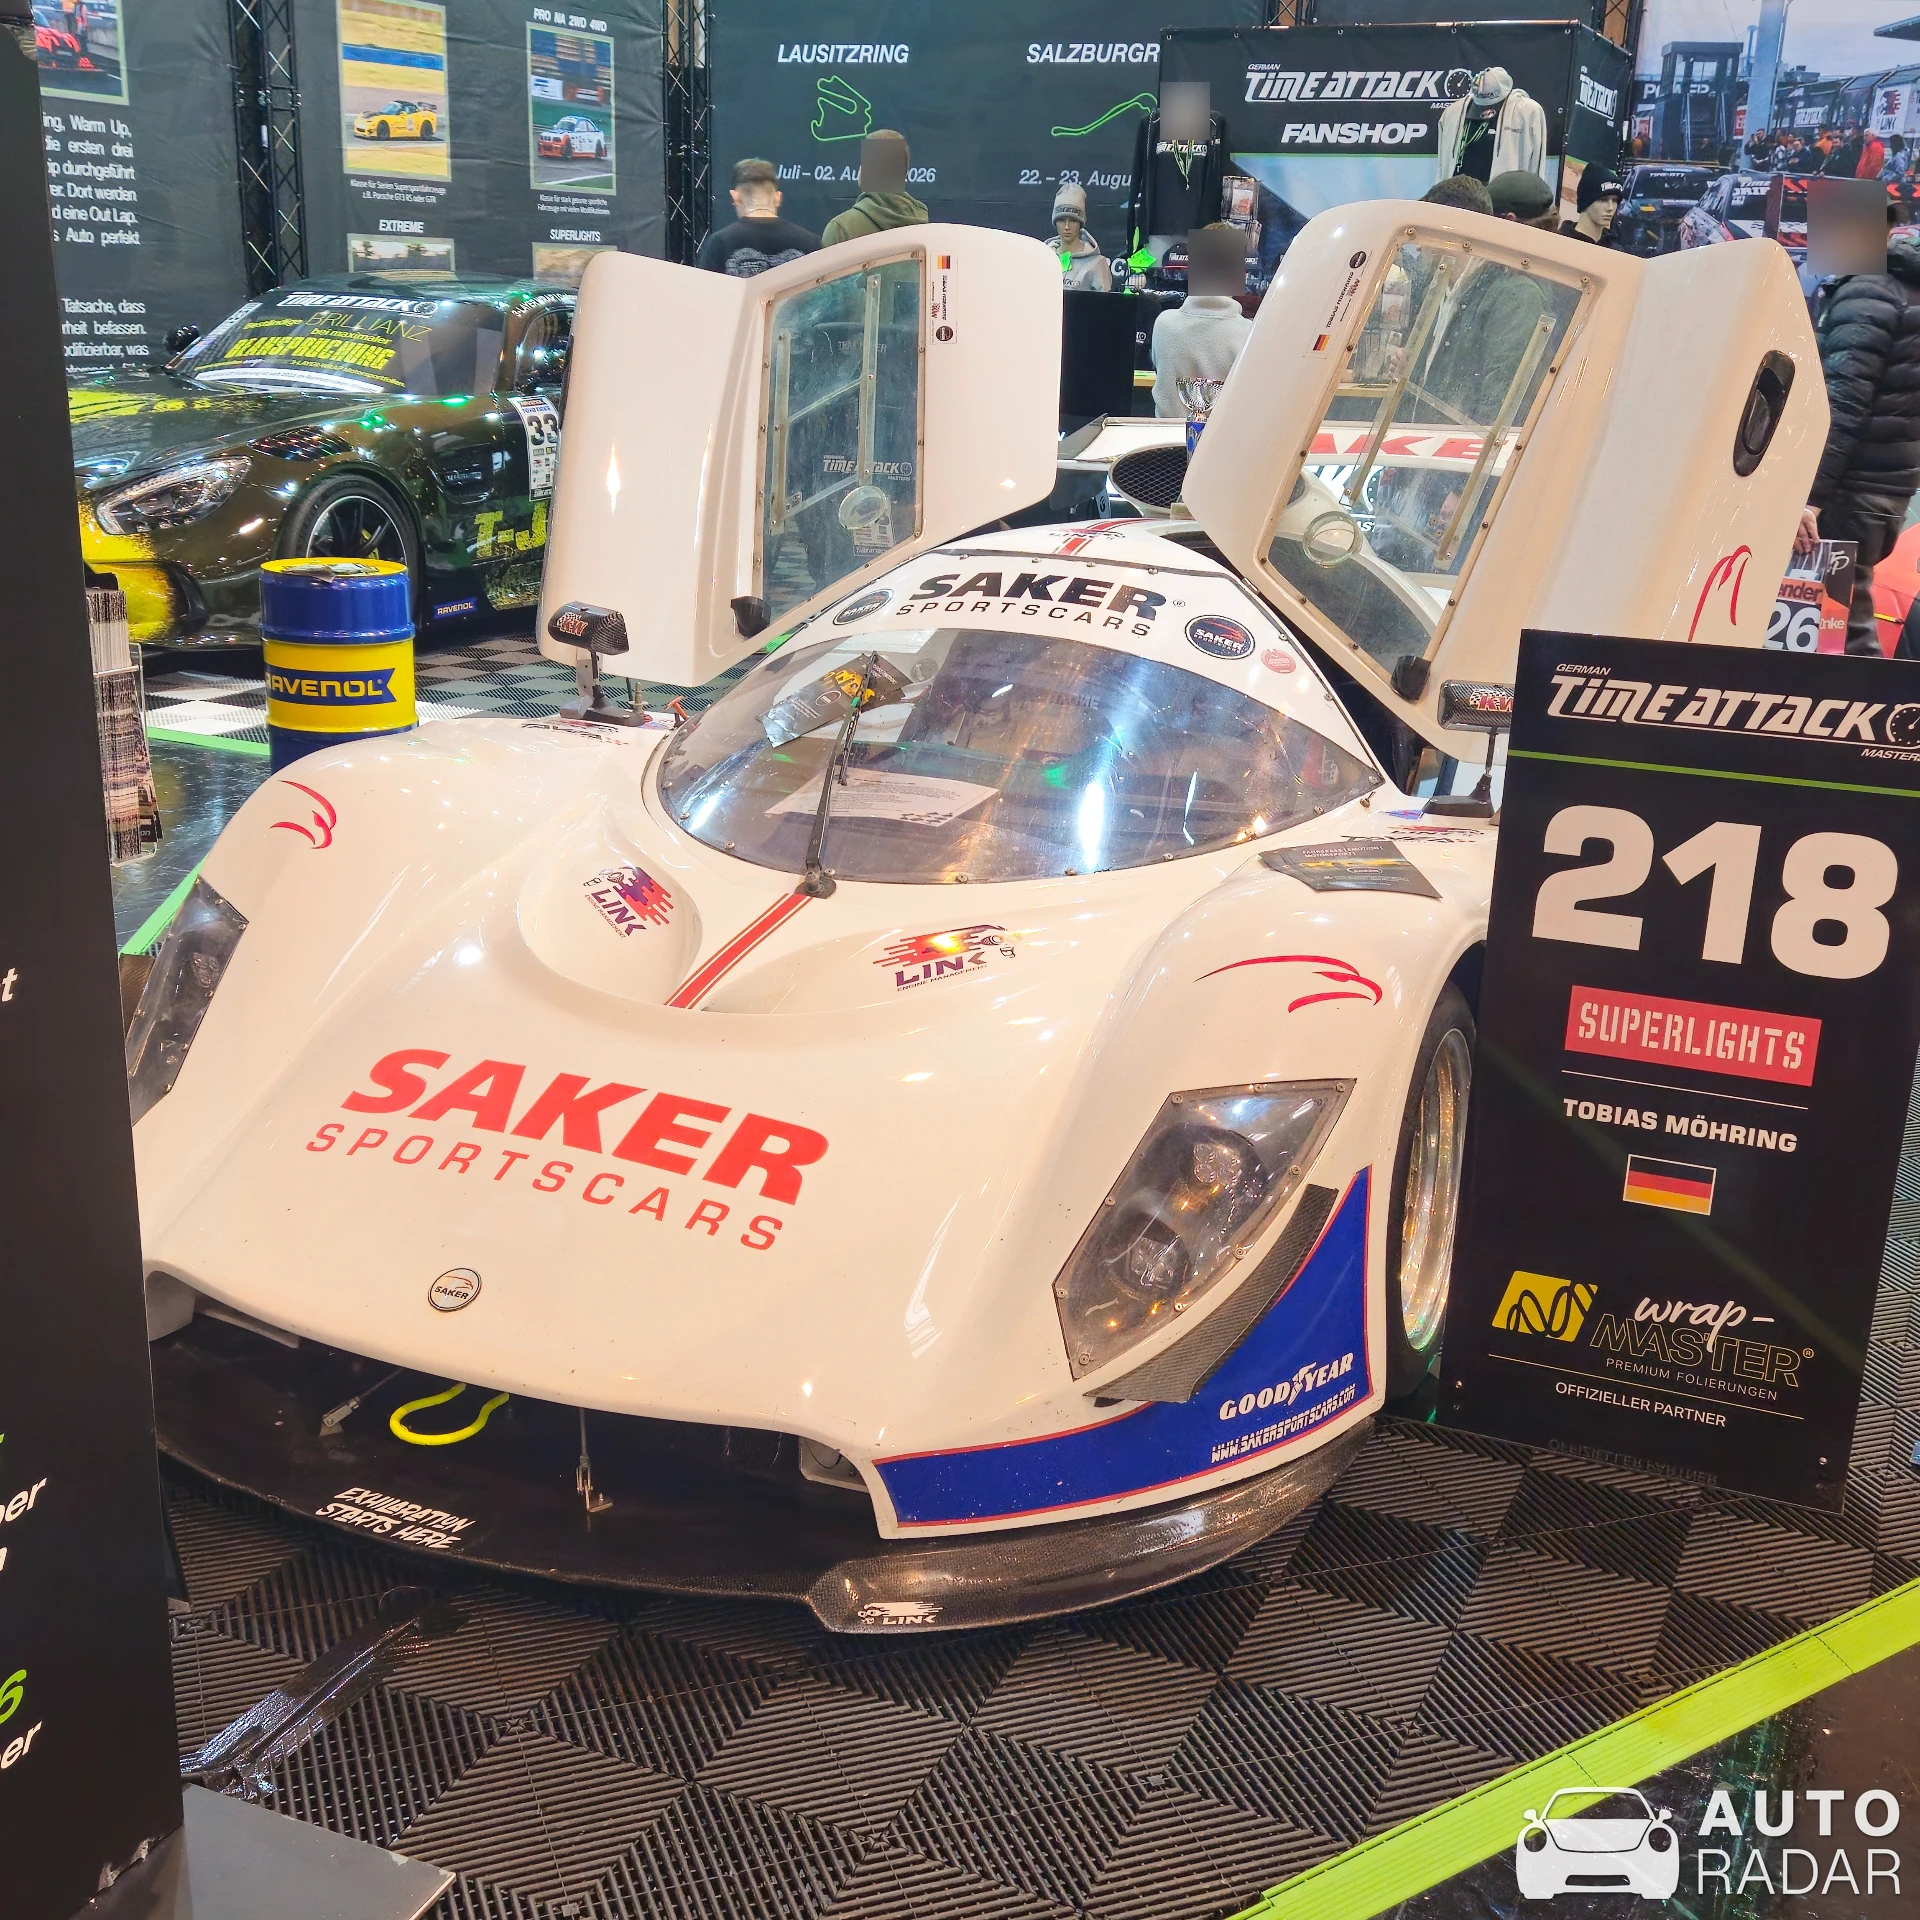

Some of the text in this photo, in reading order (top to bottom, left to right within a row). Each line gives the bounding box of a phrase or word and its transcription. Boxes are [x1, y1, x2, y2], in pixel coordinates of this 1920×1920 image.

[533, 8, 607, 32] PRO NA 2WD 4WD
[777, 43, 909, 63] LAUSITZRING
[1248, 63, 1281, 71] GERMAN
[69, 114, 106, 133] Warm
[1280, 122, 1428, 145] FANSHOP
[67, 140, 105, 156] ersten
[111, 142, 134, 158] drei
[62, 160, 136, 181] durchgeführt
[814, 165, 836, 180] 02.
[904, 167, 936, 182] 026
[1019, 169, 1042, 185] 22.
[67, 182, 94, 200] Dort
[94, 186, 137, 202] werden
[373, 191, 394, 201] Porsche
[63, 205, 88, 221] eine
[89, 206, 113, 222] Out
[113, 208, 139, 227] Lap.
[379, 219, 425, 233] EXTREME
[66, 227, 95, 244] Auto
[101, 230, 141, 247] perfekt
[550, 229, 601, 242] SUPERLIGHTS
[61, 298, 146, 315] Tatsache, dass
[93, 320, 147, 335] befassen.
[305, 311, 433, 342] BRILLIANZ
[328, 329, 392, 346] maximaler
[126, 345, 150, 356] was
[909, 571, 1168, 621] SAKER
[437, 602, 474, 615] RAVENOL
[895, 601, 1152, 637] SPORTSCARS
[1194, 628, 1245, 650] SAKER
[1556, 662, 1612, 676] GERMAN
[1531, 804, 1899, 980] 218
[591, 888, 647, 937] LINK
[894, 951, 987, 987] LINK
[896, 964, 988, 992] ENGINE MANAGEMENT
[1577, 1000, 1806, 1070] SUPERLIGHTS
[340, 1048, 830, 1207] SAKER
[1563, 1098, 1798, 1153] TOBIAS MÖHRING
[306, 1123, 783, 1251] SPORTSCARS
[434, 1285, 470, 1300] SAKER
[1219, 1352, 1354, 1421] GOODYEAR
[1606, 1357, 1778, 1402] PREMIUM FOLIERUNGEN
[1555, 1381, 1727, 1428] OFFIZIELLER PARTNER
[1211, 1382, 1356, 1464] WWW.SAKERSPORTSCARS.COM
[334, 1486, 476, 1534] EXHILARATION
[315, 1502, 461, 1549] STARTS HERE
[882, 1615, 937, 1625] LINK
